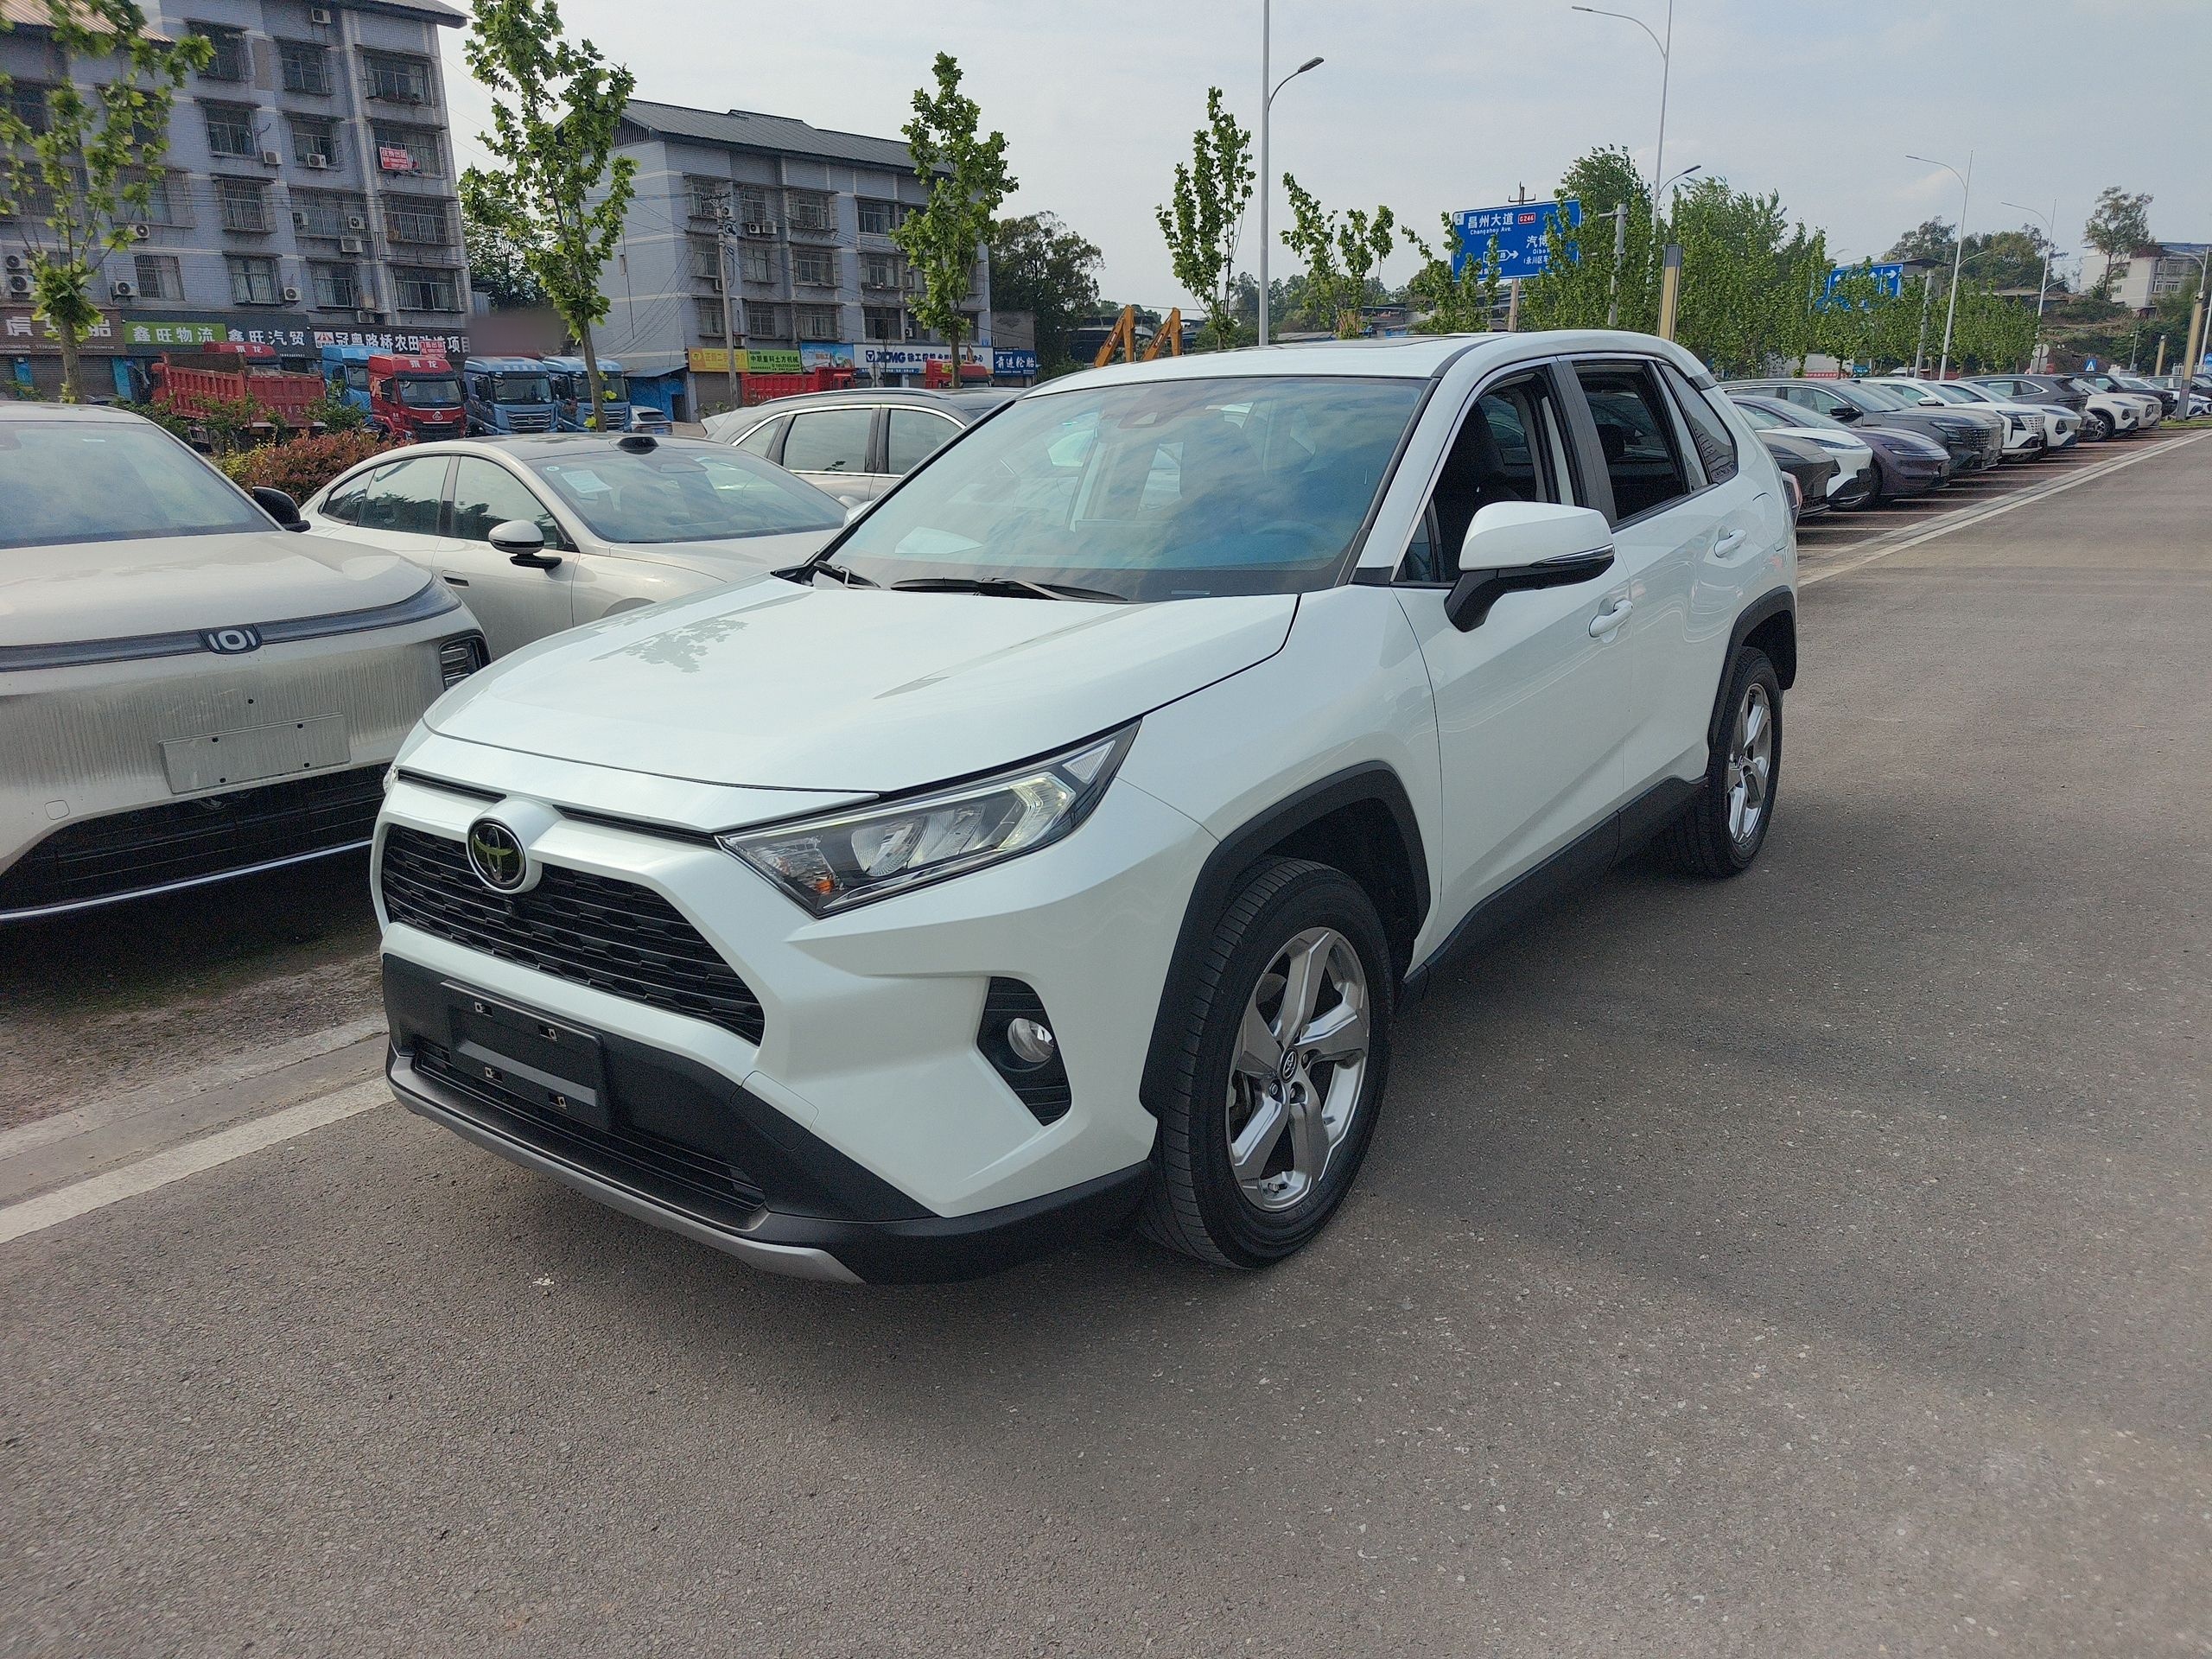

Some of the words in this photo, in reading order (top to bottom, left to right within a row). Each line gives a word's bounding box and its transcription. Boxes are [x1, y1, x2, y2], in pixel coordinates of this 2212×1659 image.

[1468, 213, 1514, 229] 昌州大道
[133, 325, 215, 343] 鑫旺物流
[228, 328, 305, 346] 鑫旺汽贸
[995, 355, 1035, 370] 前进轮胎
